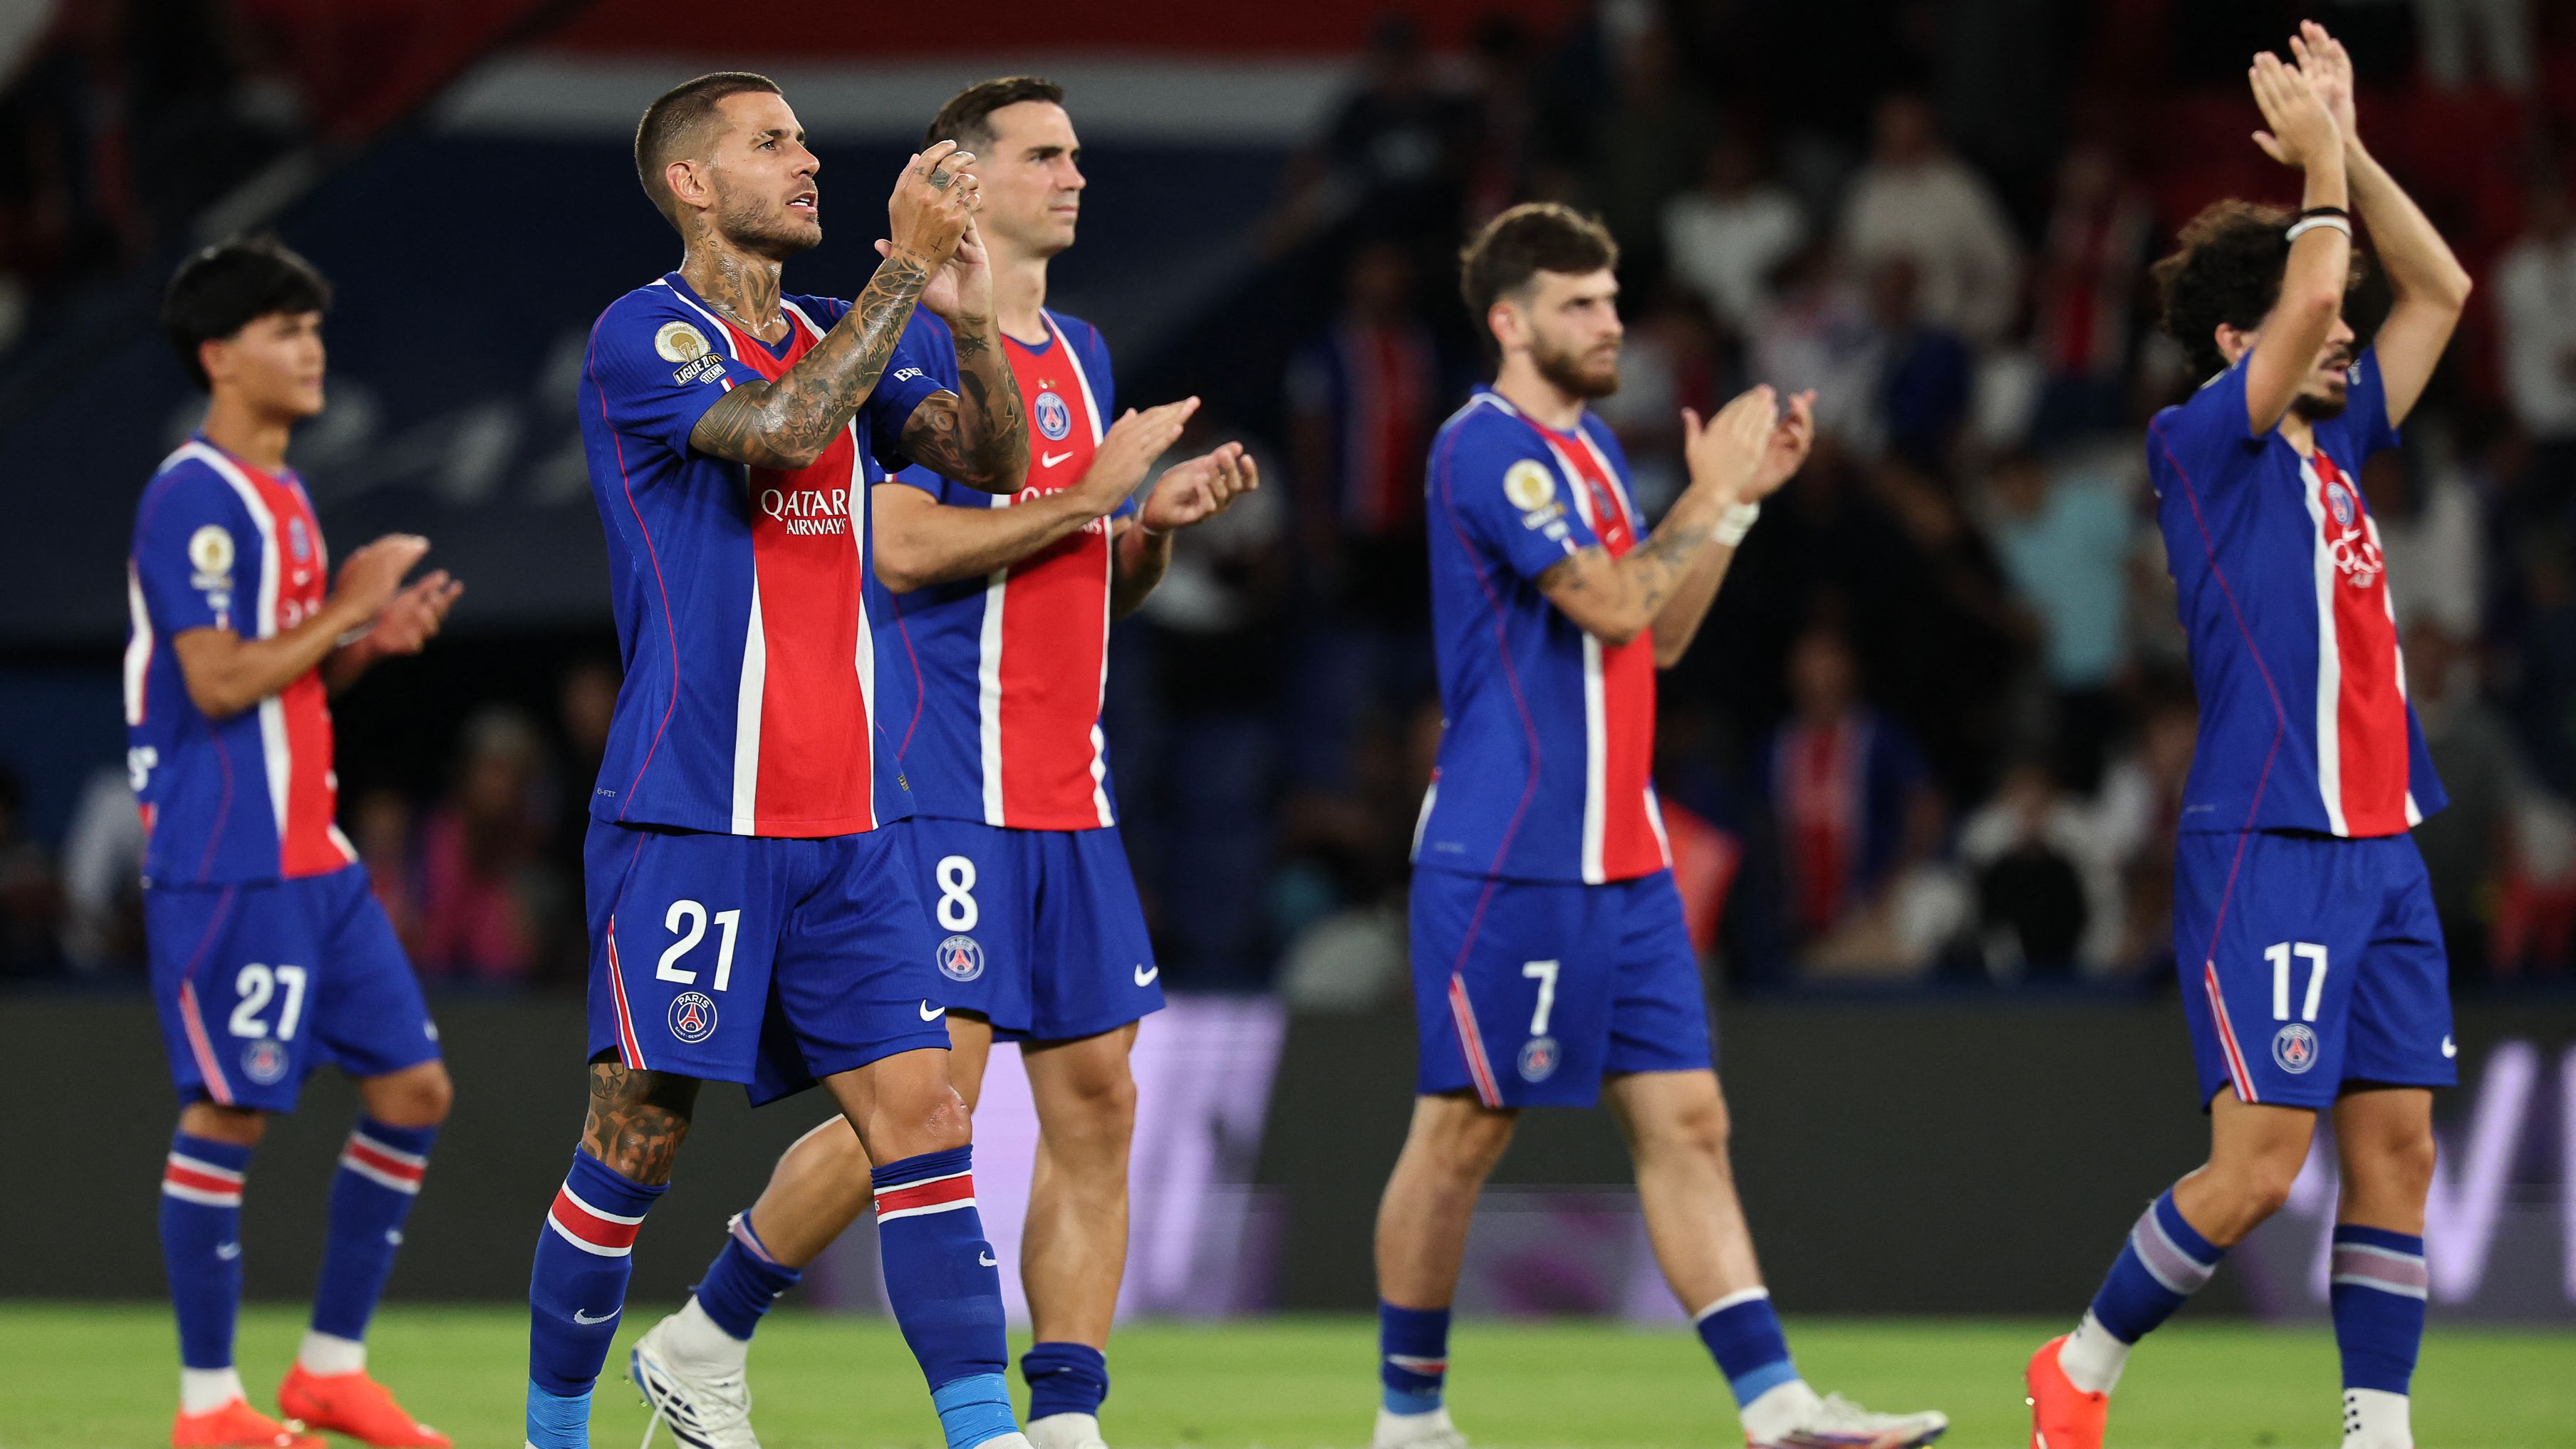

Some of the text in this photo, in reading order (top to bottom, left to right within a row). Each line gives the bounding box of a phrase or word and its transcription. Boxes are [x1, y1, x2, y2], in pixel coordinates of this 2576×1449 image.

[675, 360, 705, 383] LIGUE
[761, 489, 848, 522] QATAR
[786, 518, 846, 536] AIRWAYS
[936, 855, 978, 933] 8
[655, 899, 741, 992] 21
[228, 962, 308, 1042] 27
[677, 994, 710, 1009] PARIS
[1522, 959, 1560, 1037] 7
[2264, 941, 2328, 1022] 17
[674, 1026, 707, 1039] SAINT GERMAIN
